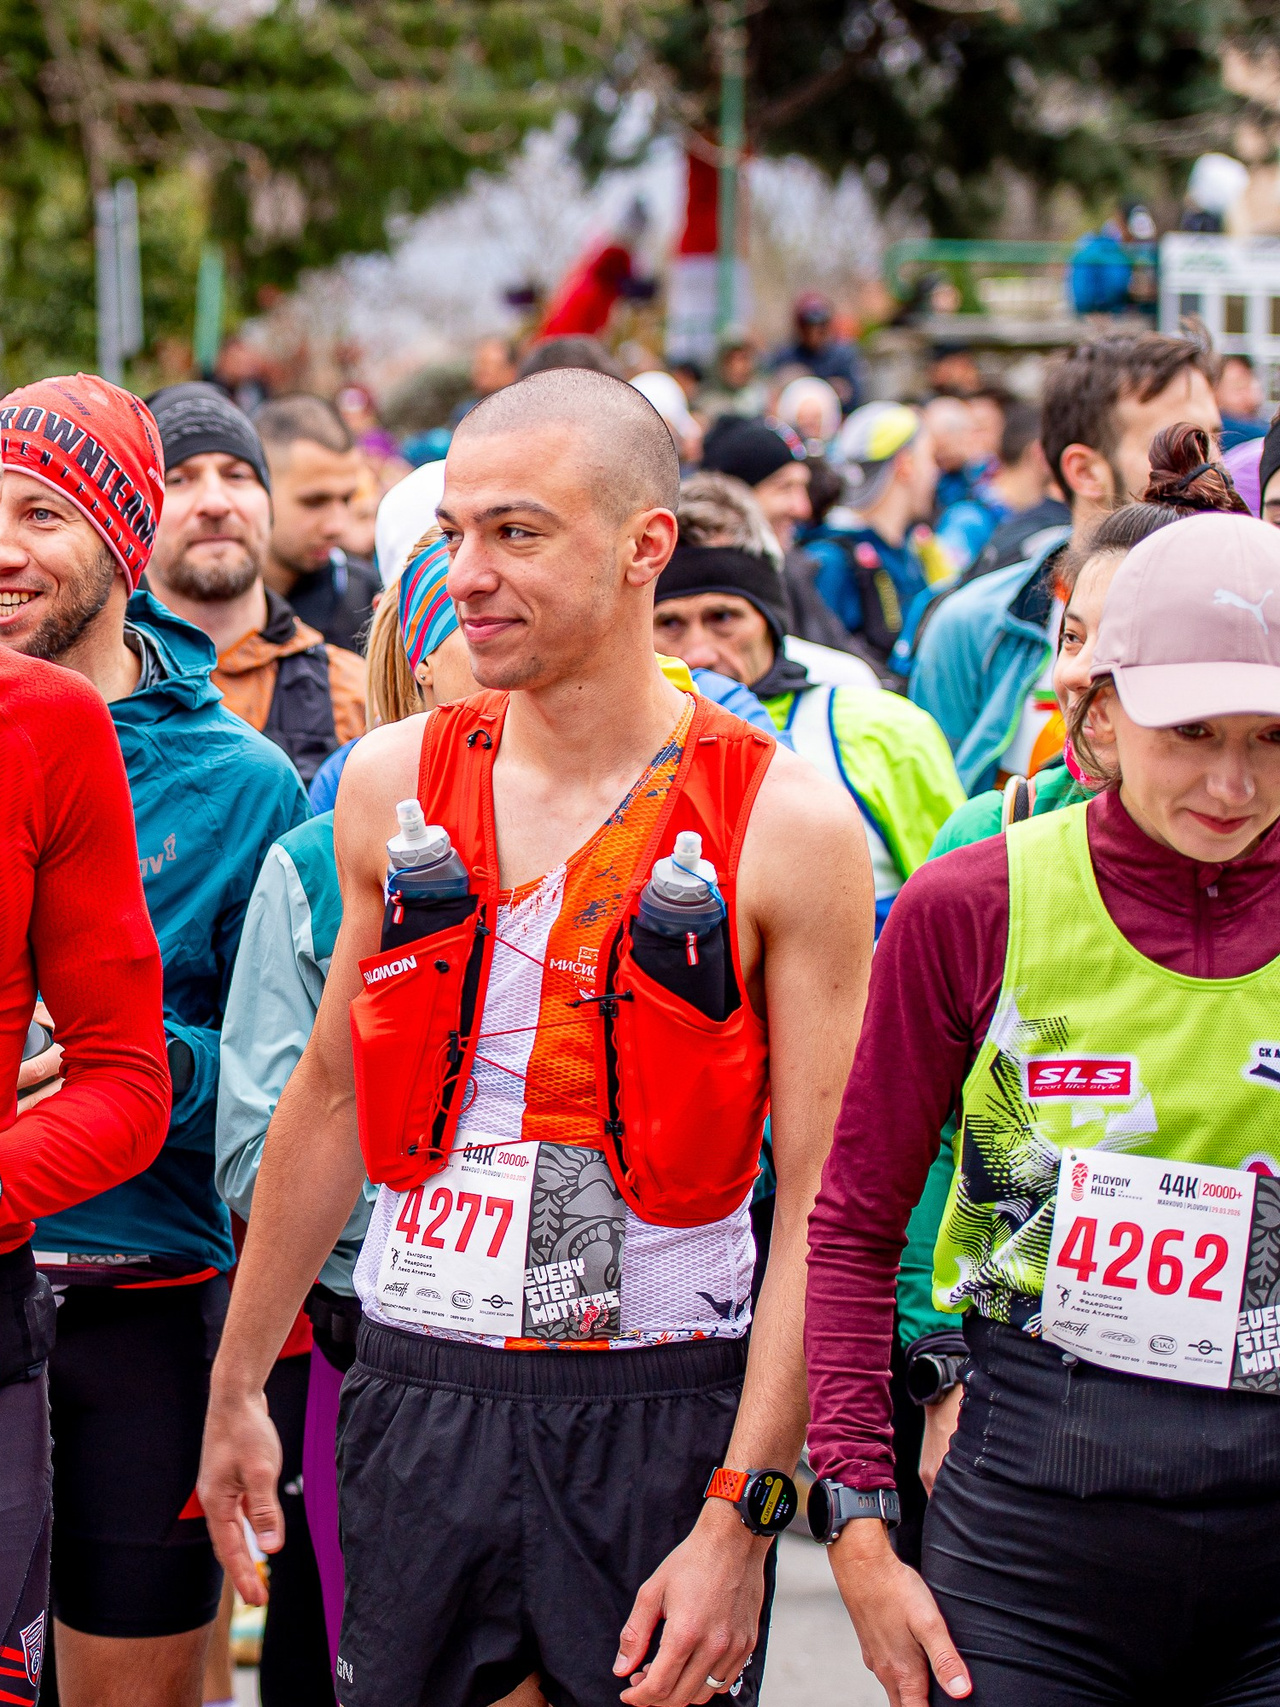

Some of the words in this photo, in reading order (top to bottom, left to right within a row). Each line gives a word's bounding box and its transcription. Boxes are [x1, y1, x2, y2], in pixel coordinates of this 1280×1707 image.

[0, 406, 157, 549] ROWNTEAM
[1034, 1066, 1126, 1085] SLS
[462, 1142, 496, 1166] 44K
[1090, 1185, 1116, 1197] HILLS
[1092, 1174, 1131, 1187] PLOVDIV
[1159, 1173, 1199, 1199] 44K
[1202, 1183, 1243, 1200] 2000D+
[396, 1185, 514, 1258] 4277
[524, 1257, 586, 1287] EVERY
[1056, 1216, 1230, 1302] 4262
[525, 1279, 576, 1306] STEP
[529, 1290, 621, 1325] MATTERS
[1236, 1304, 1280, 1333] EVE
